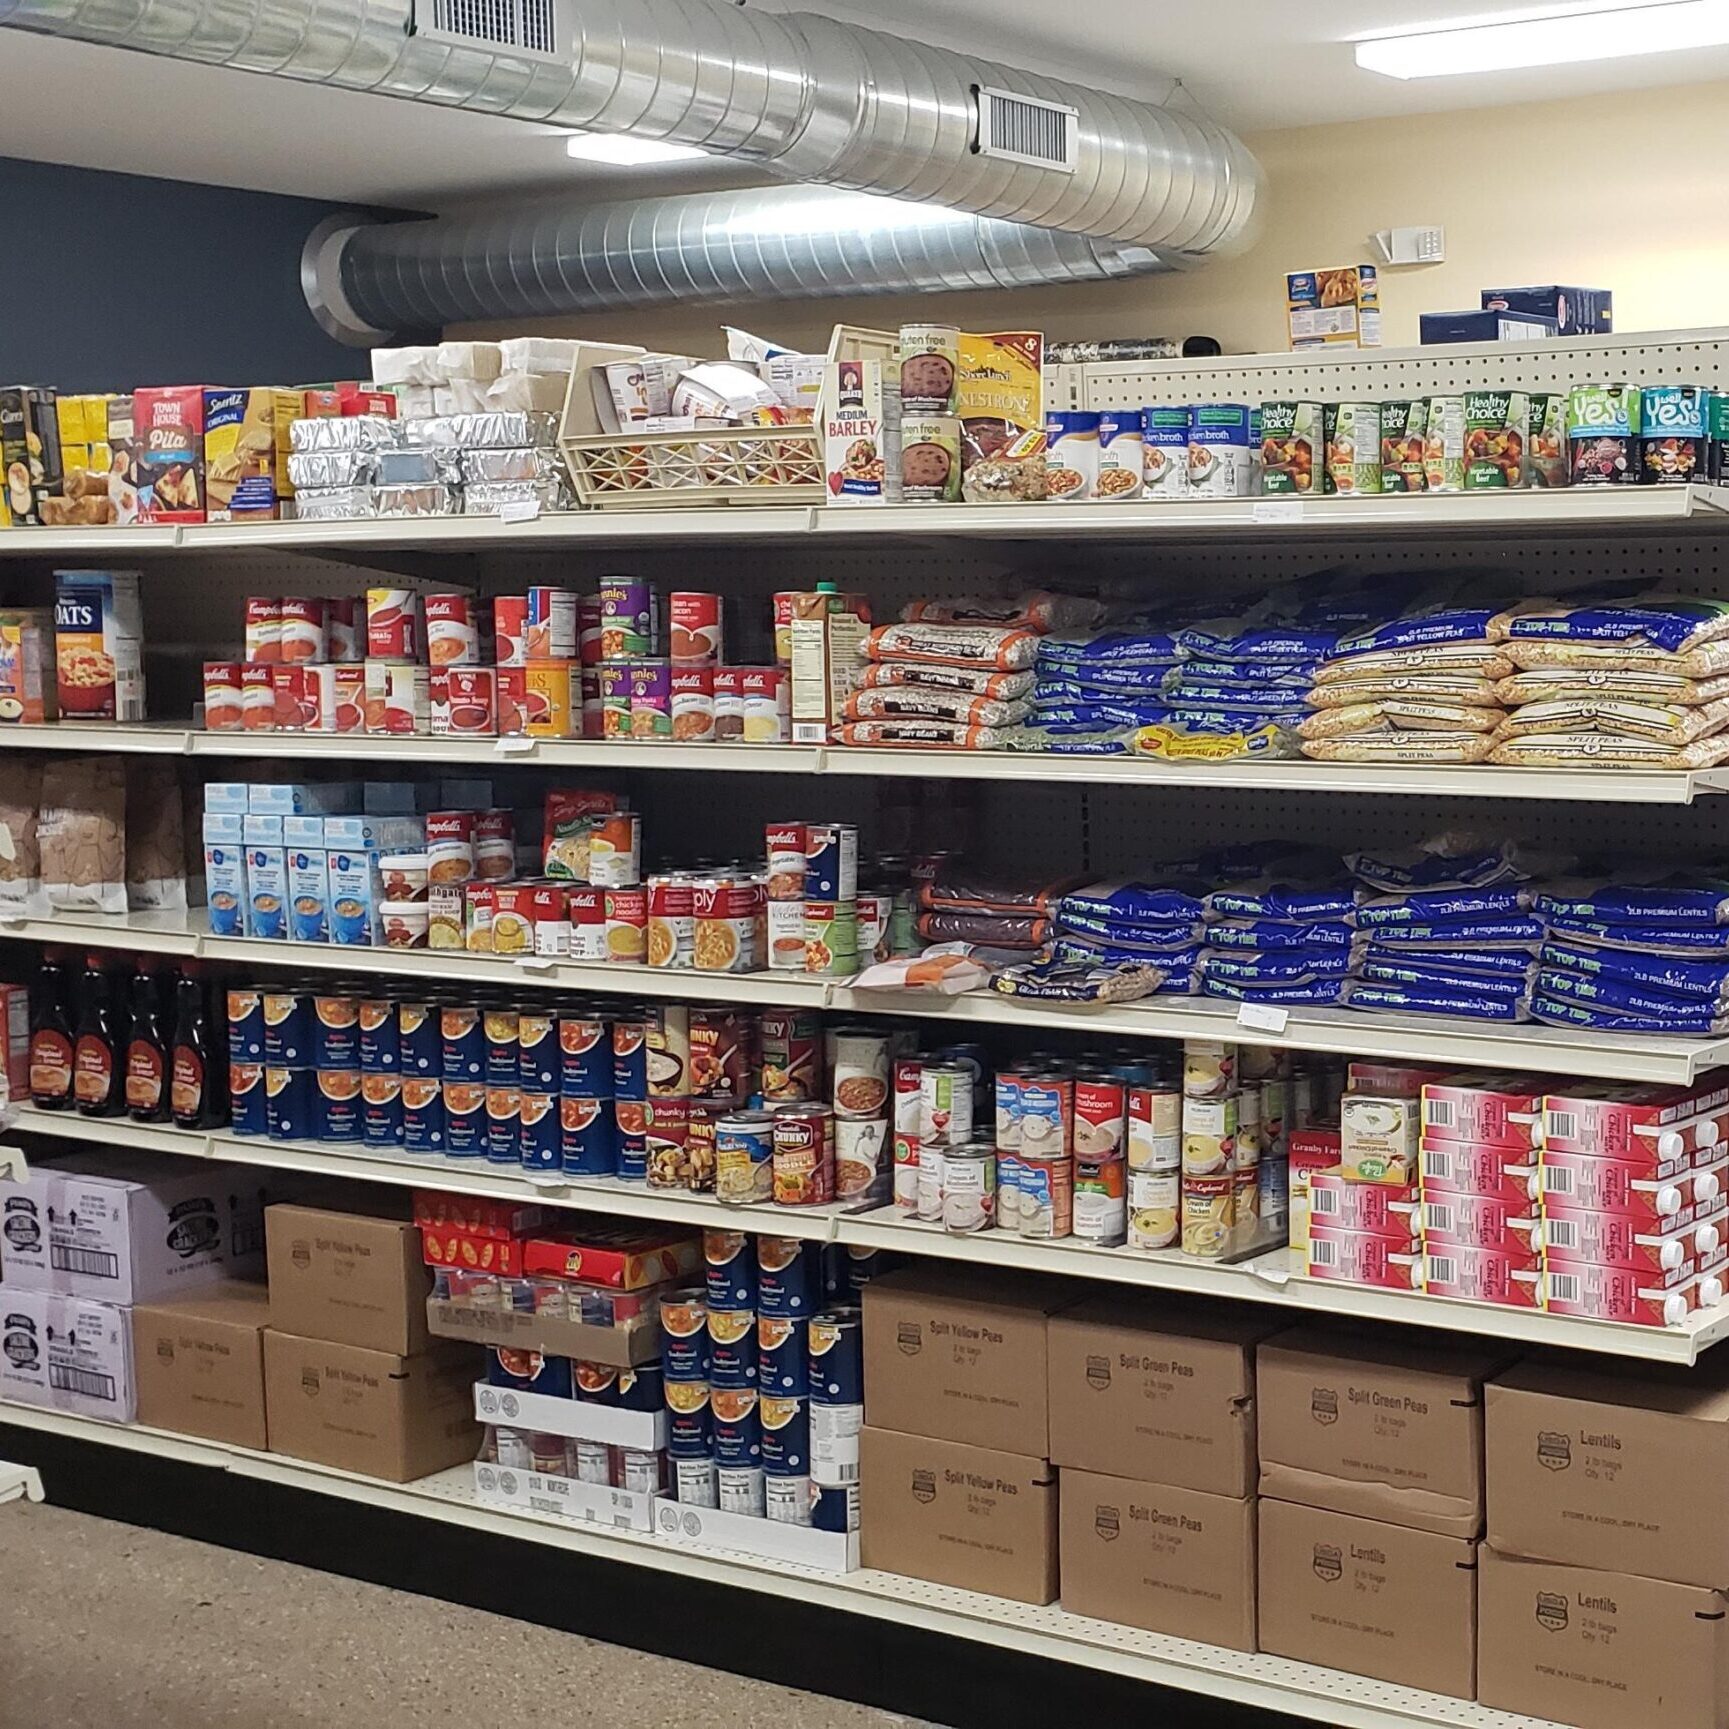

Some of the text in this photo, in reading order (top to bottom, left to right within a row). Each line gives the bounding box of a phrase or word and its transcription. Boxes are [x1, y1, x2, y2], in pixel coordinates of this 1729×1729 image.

[926, 333, 946, 346] free
[1470, 394, 1510, 408] Healthy
[153, 402, 181, 415] TOWN
[1466, 405, 1506, 421] Choice
[153, 414, 182, 426] HOUSE
[836, 411, 868, 421] MEDIUM
[1382, 416, 1406, 428] oice
[829, 421, 877, 437] BARLEY
[920, 423, 940, 434] free
[1205, 430, 1230, 441] broth
[150, 430, 186, 449] Pita
[1159, 432, 1183, 442] broth
[601, 588, 628, 602] nnie's
[603, 668, 624, 682] nie's
[694, 892, 716, 911] ply
[1679, 907, 1708, 917] LENTILS
[1556, 953, 1576, 965] TOP
[1556, 978, 1573, 990] TOP
[1546, 1002, 1564, 1014] TOP
[1292, 1142, 1321, 1156] Granby
[1187, 1206, 1211, 1216] Chicken
[930, 1320, 1003, 1344] Split Yellow Peas
[1120, 1353, 1194, 1377] Split Green Peas
[1348, 1387, 1428, 1414] Split Green Peas
[1580, 1430, 1621, 1450] Lentils
[945, 1470, 1017, 1495] Split Yellow Peas
[1129, 1505, 1202, 1532] Split Green Peas
[1351, 1544, 1385, 1565] Lentils
[1578, 1592, 1617, 1613] Lentils
